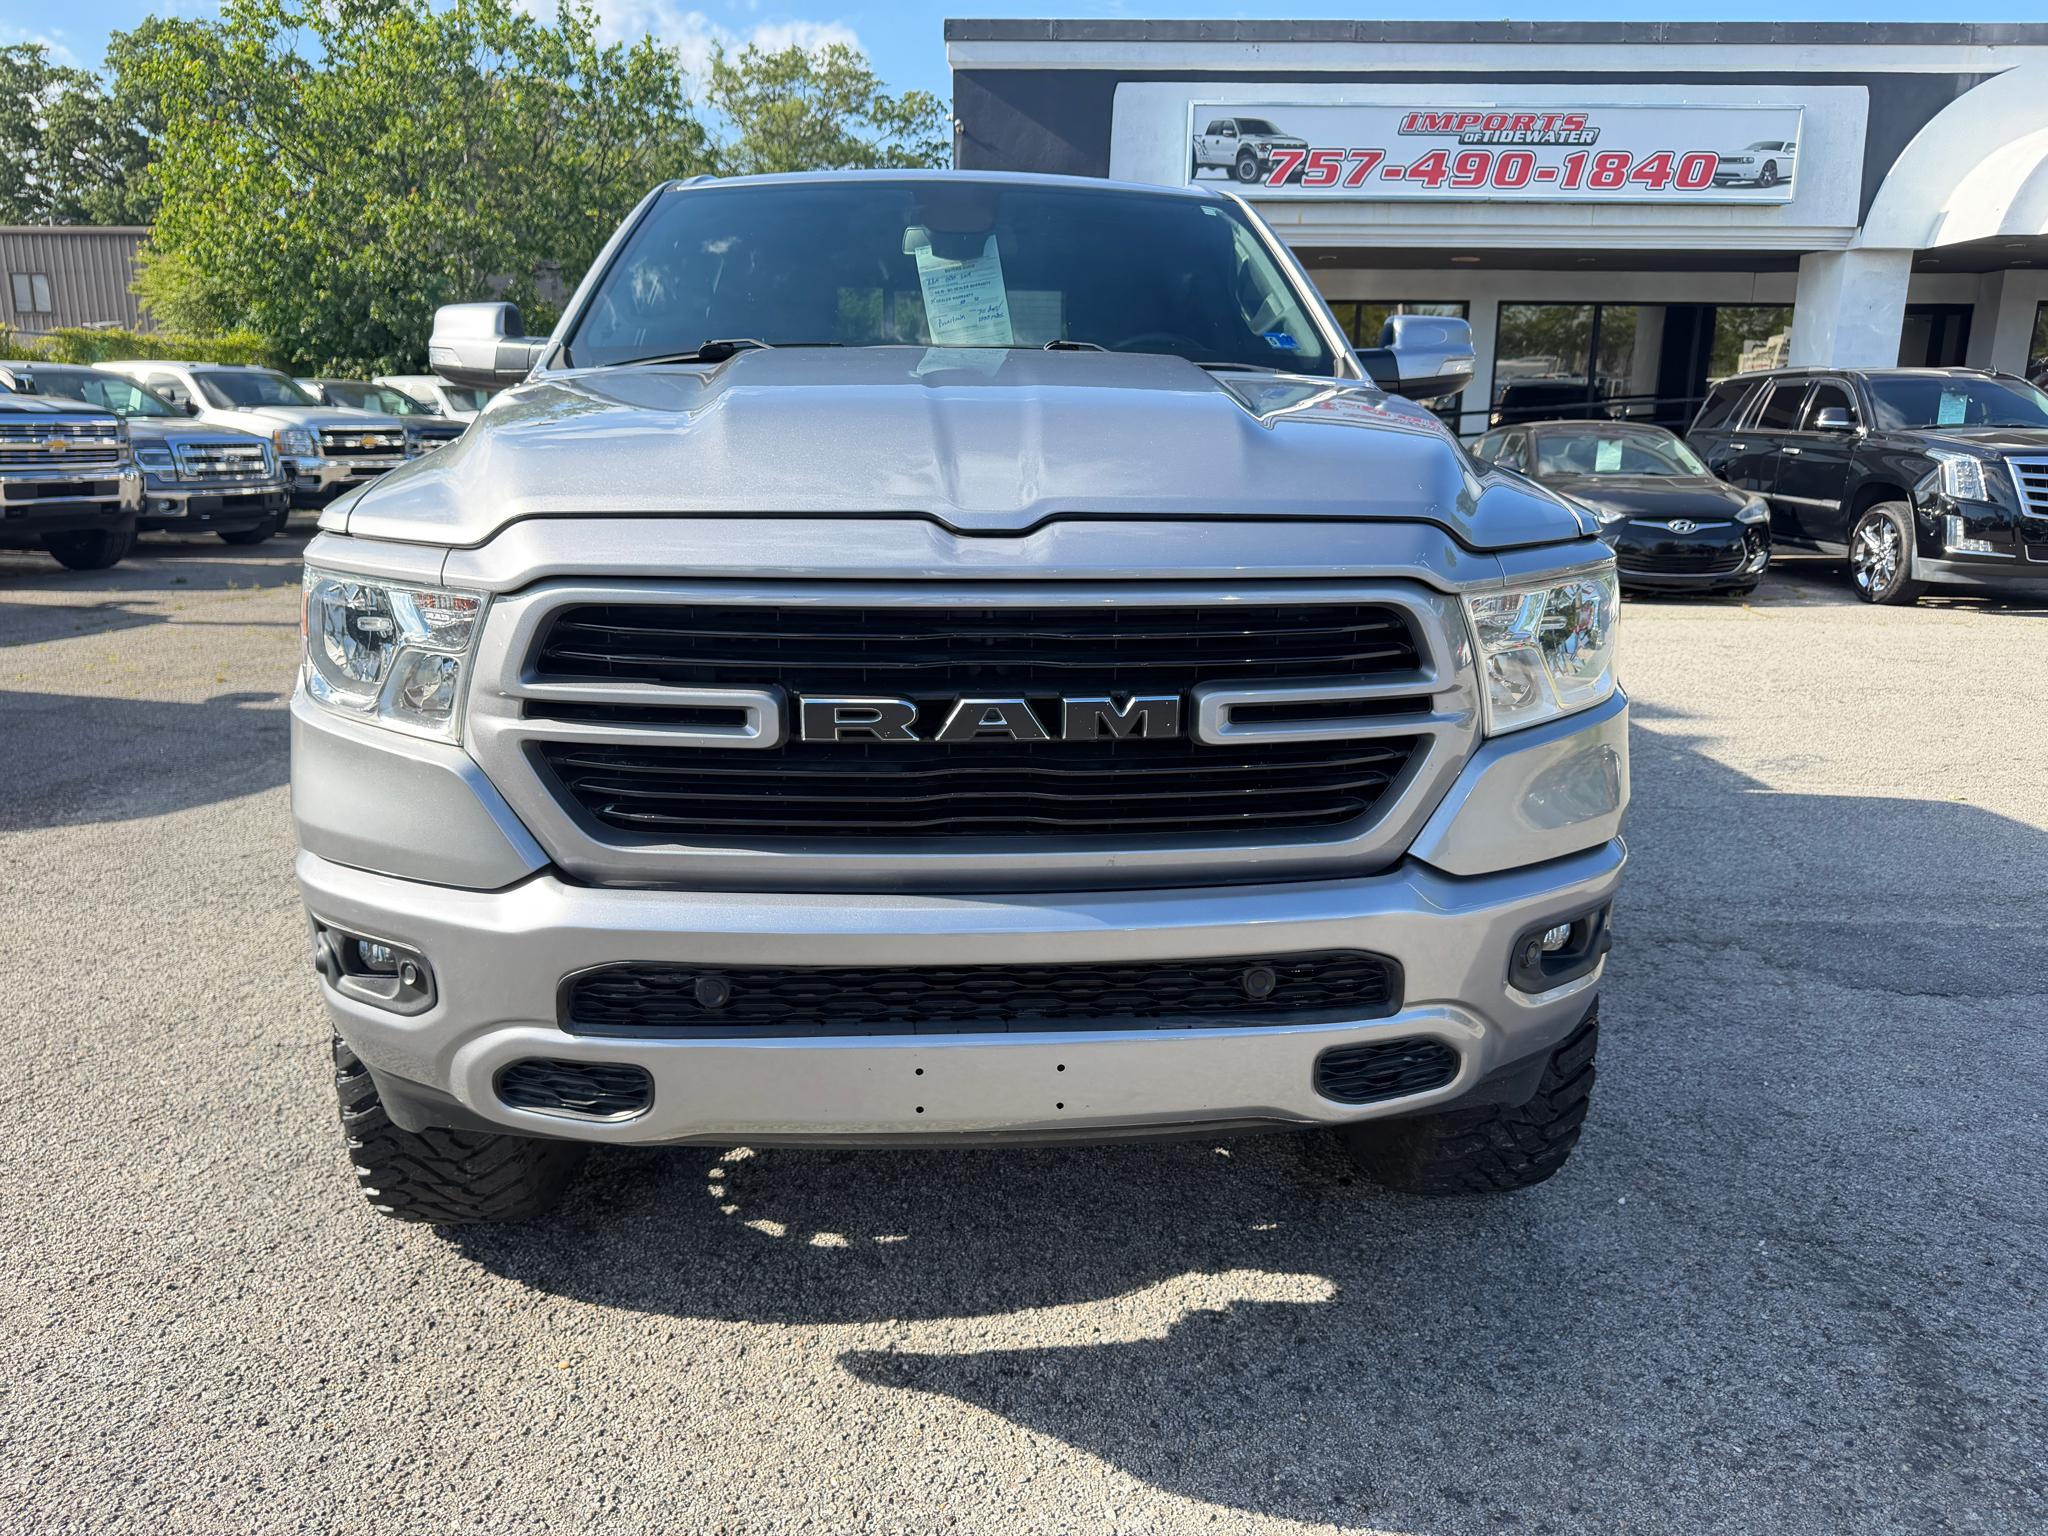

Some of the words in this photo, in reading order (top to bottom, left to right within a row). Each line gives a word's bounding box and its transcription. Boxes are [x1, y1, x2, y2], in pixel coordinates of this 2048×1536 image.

[1402, 111, 1589, 132] IMPORTS
[1463, 133, 1483, 143] OF
[1482, 129, 1596, 144] TIDEWATER
[1265, 149, 1720, 191] 757-490-1840
[799, 695, 1182, 742] RAM
